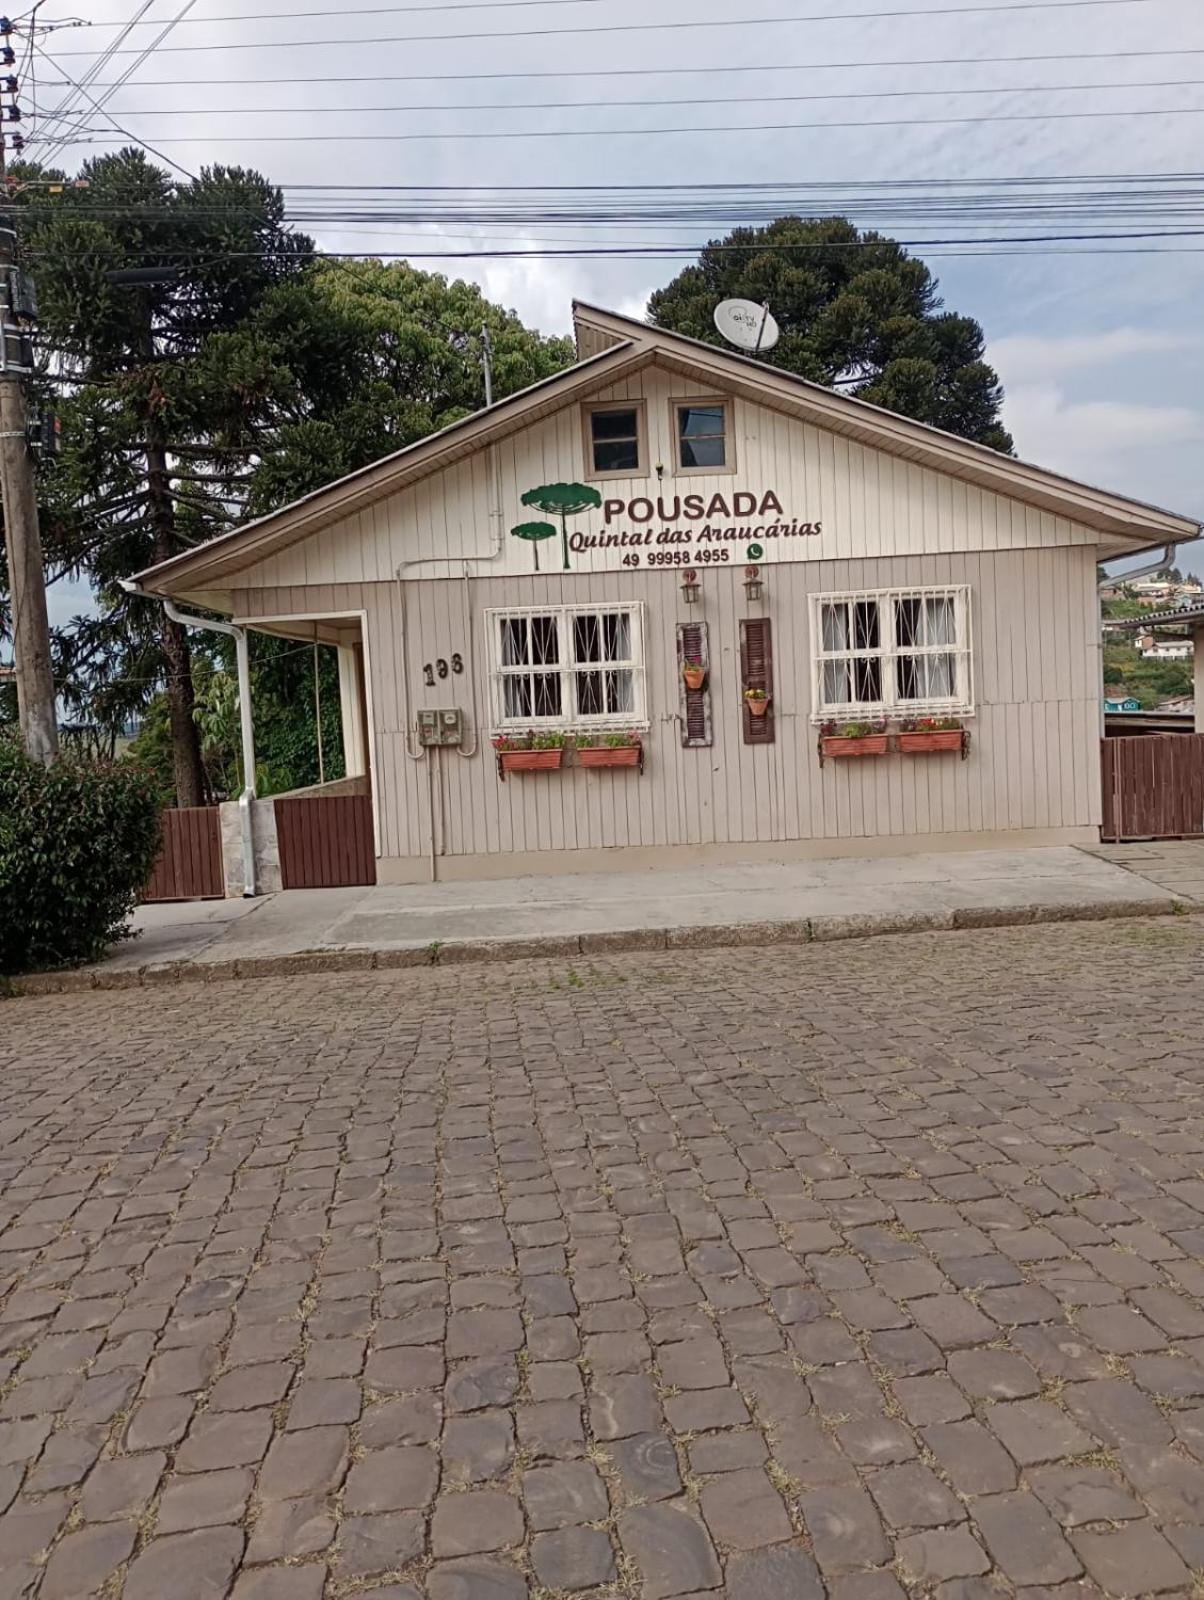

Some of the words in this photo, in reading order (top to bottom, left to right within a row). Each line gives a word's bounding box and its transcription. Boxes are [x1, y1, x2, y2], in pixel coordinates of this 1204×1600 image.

[604, 489, 783, 525] POUSADA
[569, 528, 654, 553] Quintal
[656, 527, 693, 545] das
[696, 517, 822, 543] Araucárias
[622, 553, 640, 567] 49
[647, 550, 690, 566] 99958
[694, 548, 730, 563] 4955
